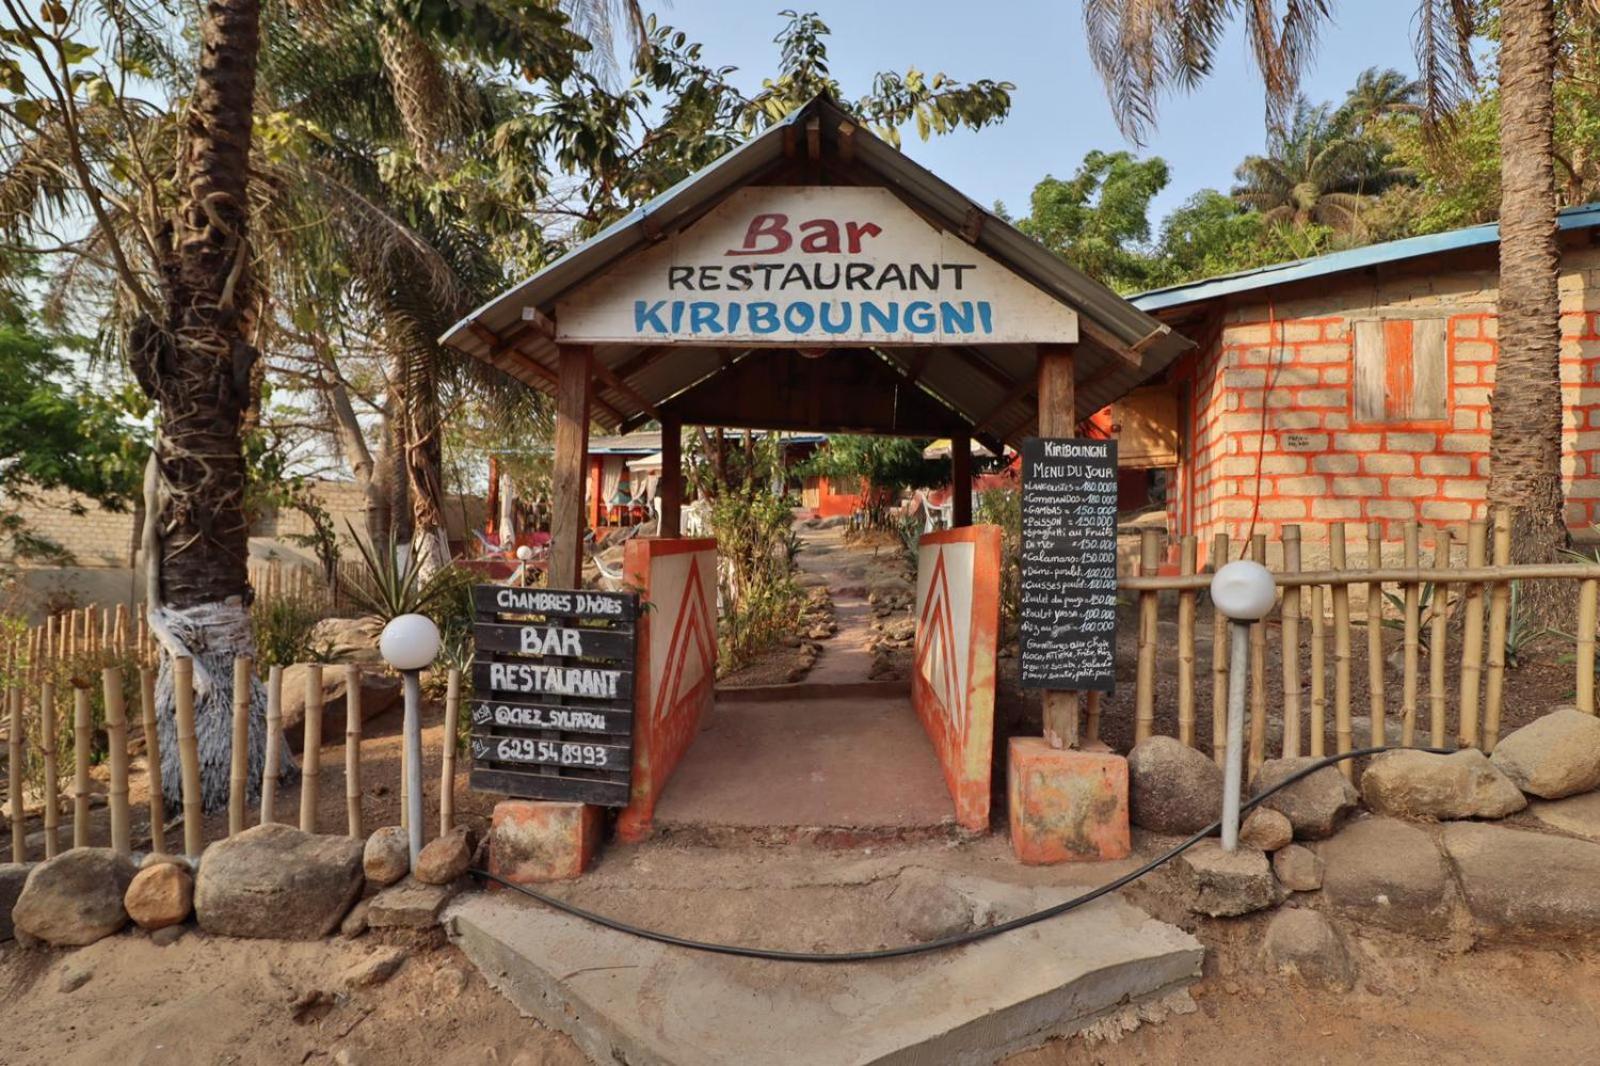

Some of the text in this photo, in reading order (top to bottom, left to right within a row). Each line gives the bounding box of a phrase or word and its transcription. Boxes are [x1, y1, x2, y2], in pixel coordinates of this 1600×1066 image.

[724, 212, 884, 256] Bar
[669, 262, 977, 291] RESTAURANT
[633, 300, 994, 335] KIRIBOUNGNI
[1033, 461, 1114, 479] MENU DU JOUR
[519, 626, 583, 656] BAR
[490, 663, 621, 697] RESTAURANT
